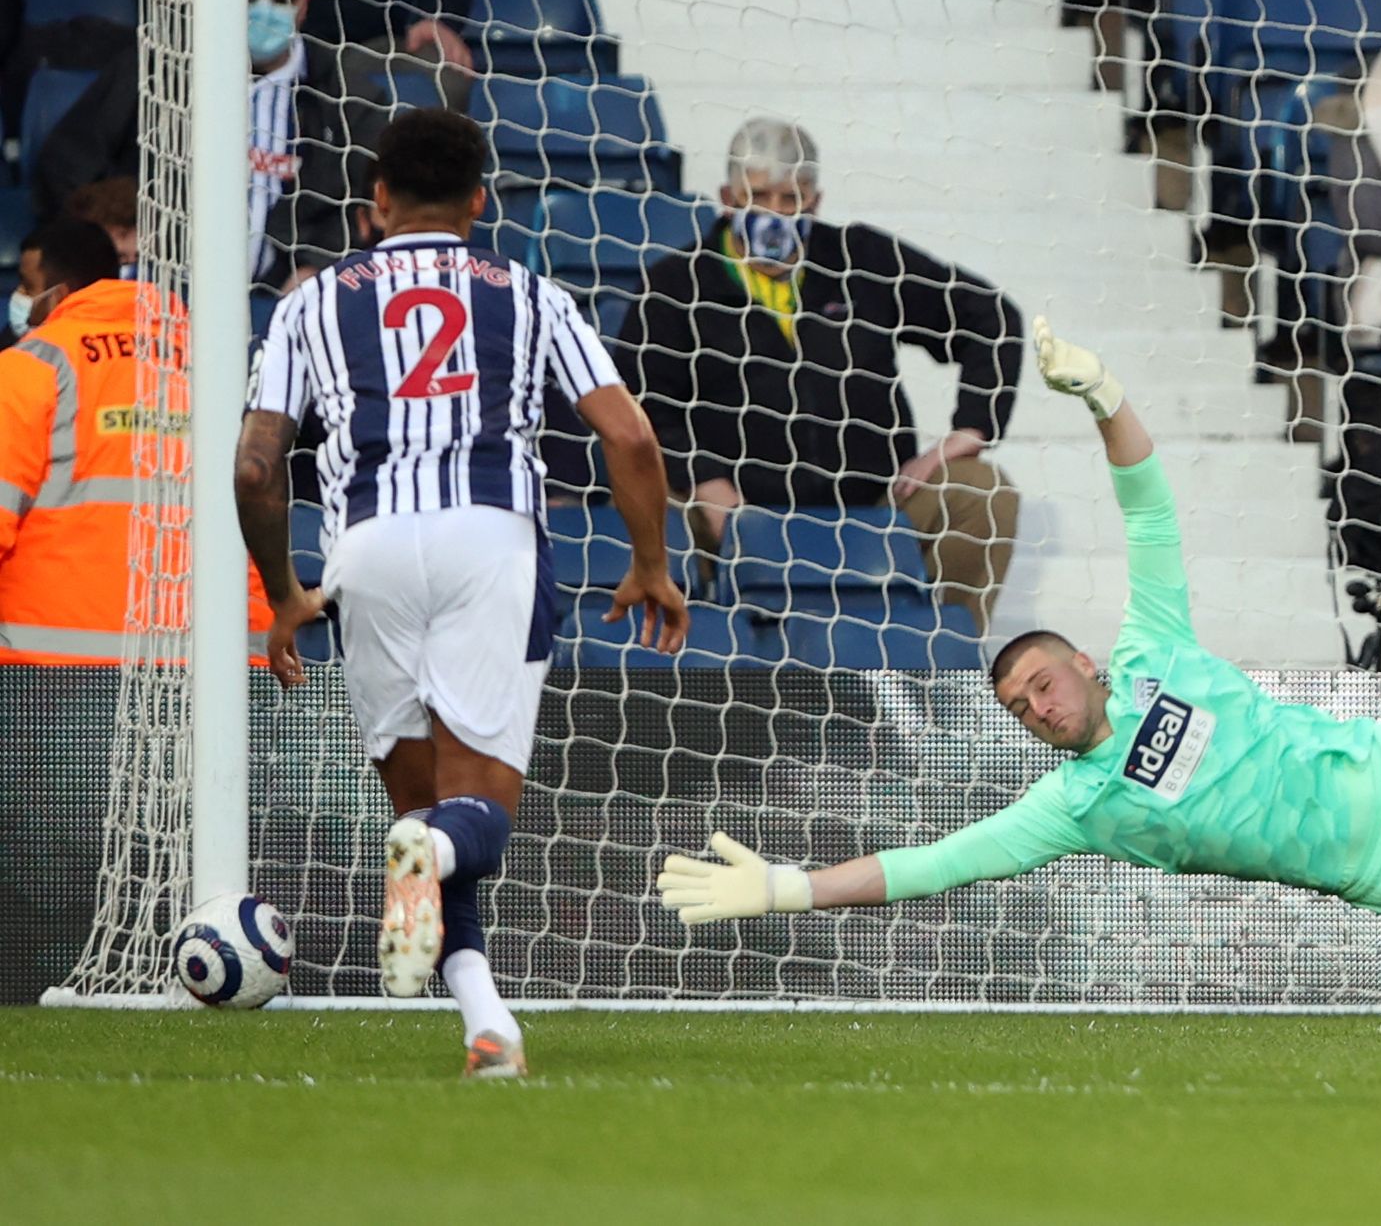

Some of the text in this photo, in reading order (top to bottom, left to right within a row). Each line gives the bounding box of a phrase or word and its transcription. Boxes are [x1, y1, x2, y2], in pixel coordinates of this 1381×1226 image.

[337, 254, 513, 292] FURLONG
[382, 286, 477, 399] 2
[1127, 699, 1188, 782] ideal
[1165, 717, 1207, 792] BOILERS
